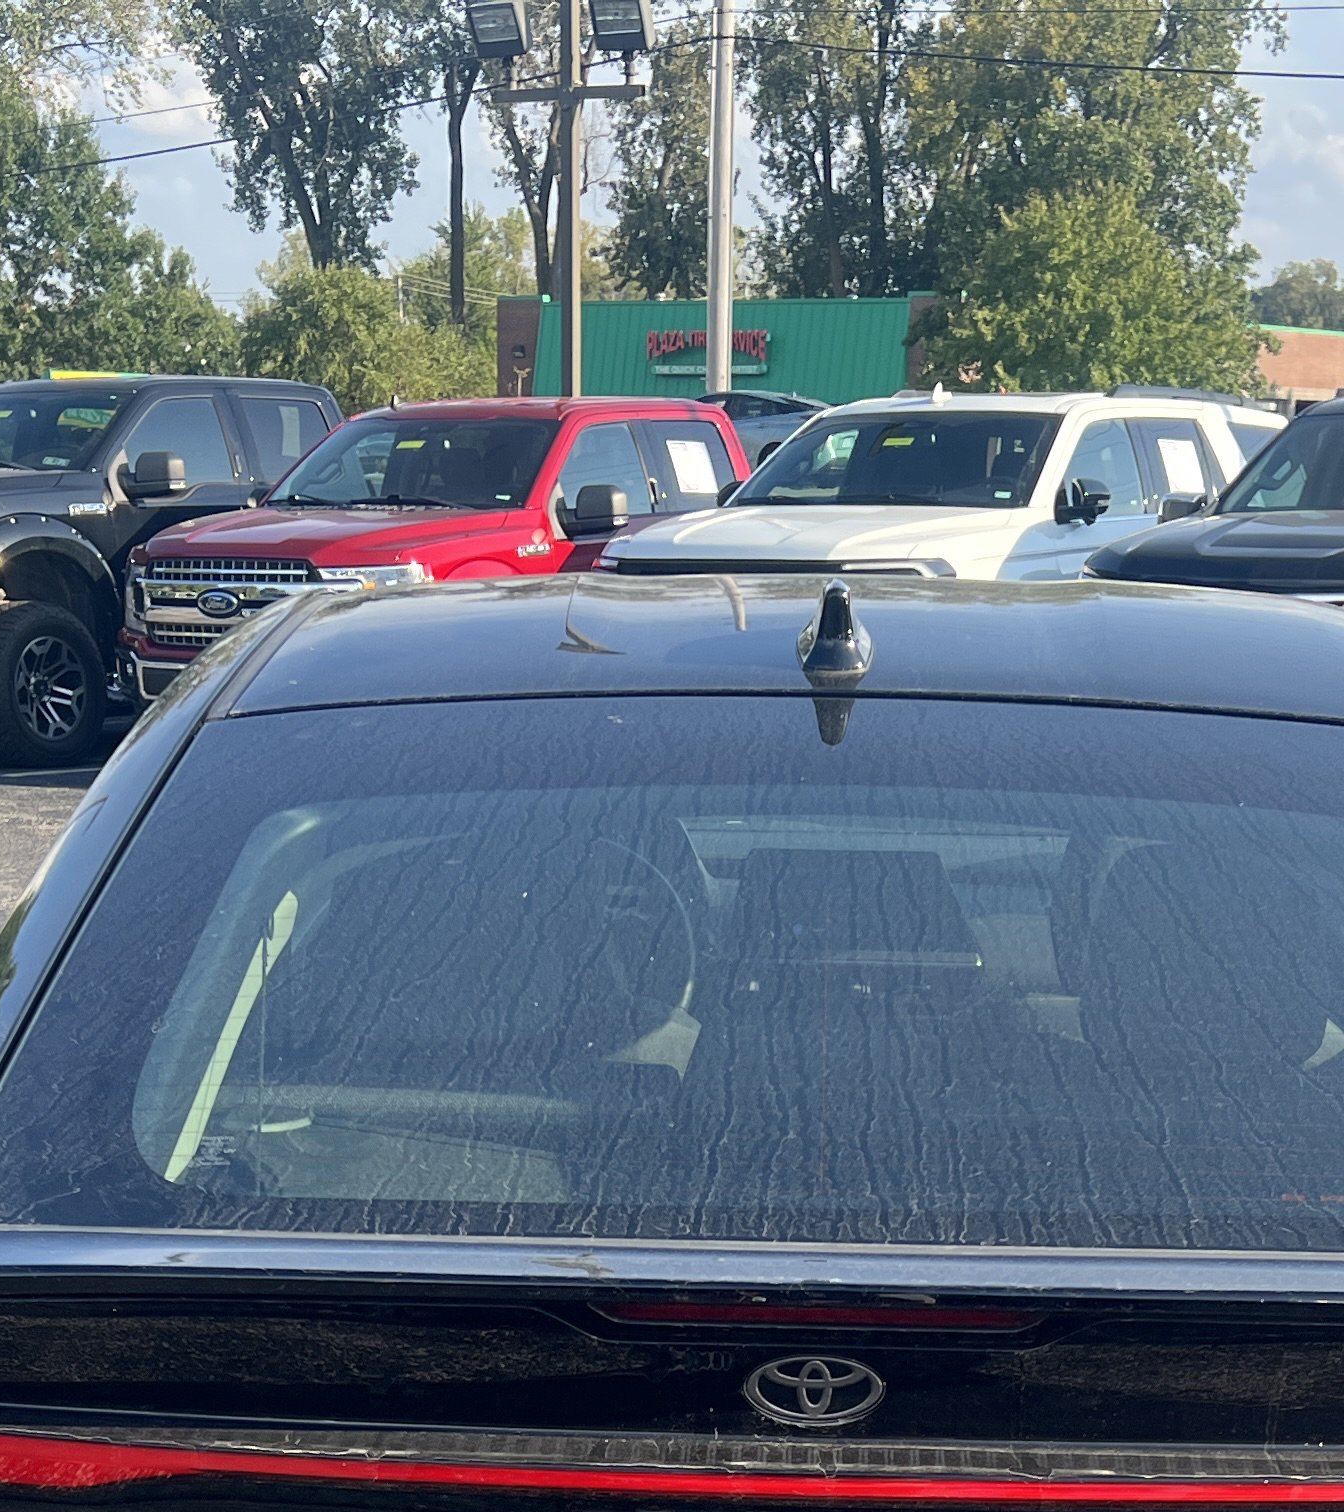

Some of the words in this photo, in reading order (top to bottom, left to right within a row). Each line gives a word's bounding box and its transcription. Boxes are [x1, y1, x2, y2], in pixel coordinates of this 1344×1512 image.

[647, 331, 685, 362] PLAZA
[688, 330, 707, 348] TIR
[732, 330, 767, 361] RVICE
